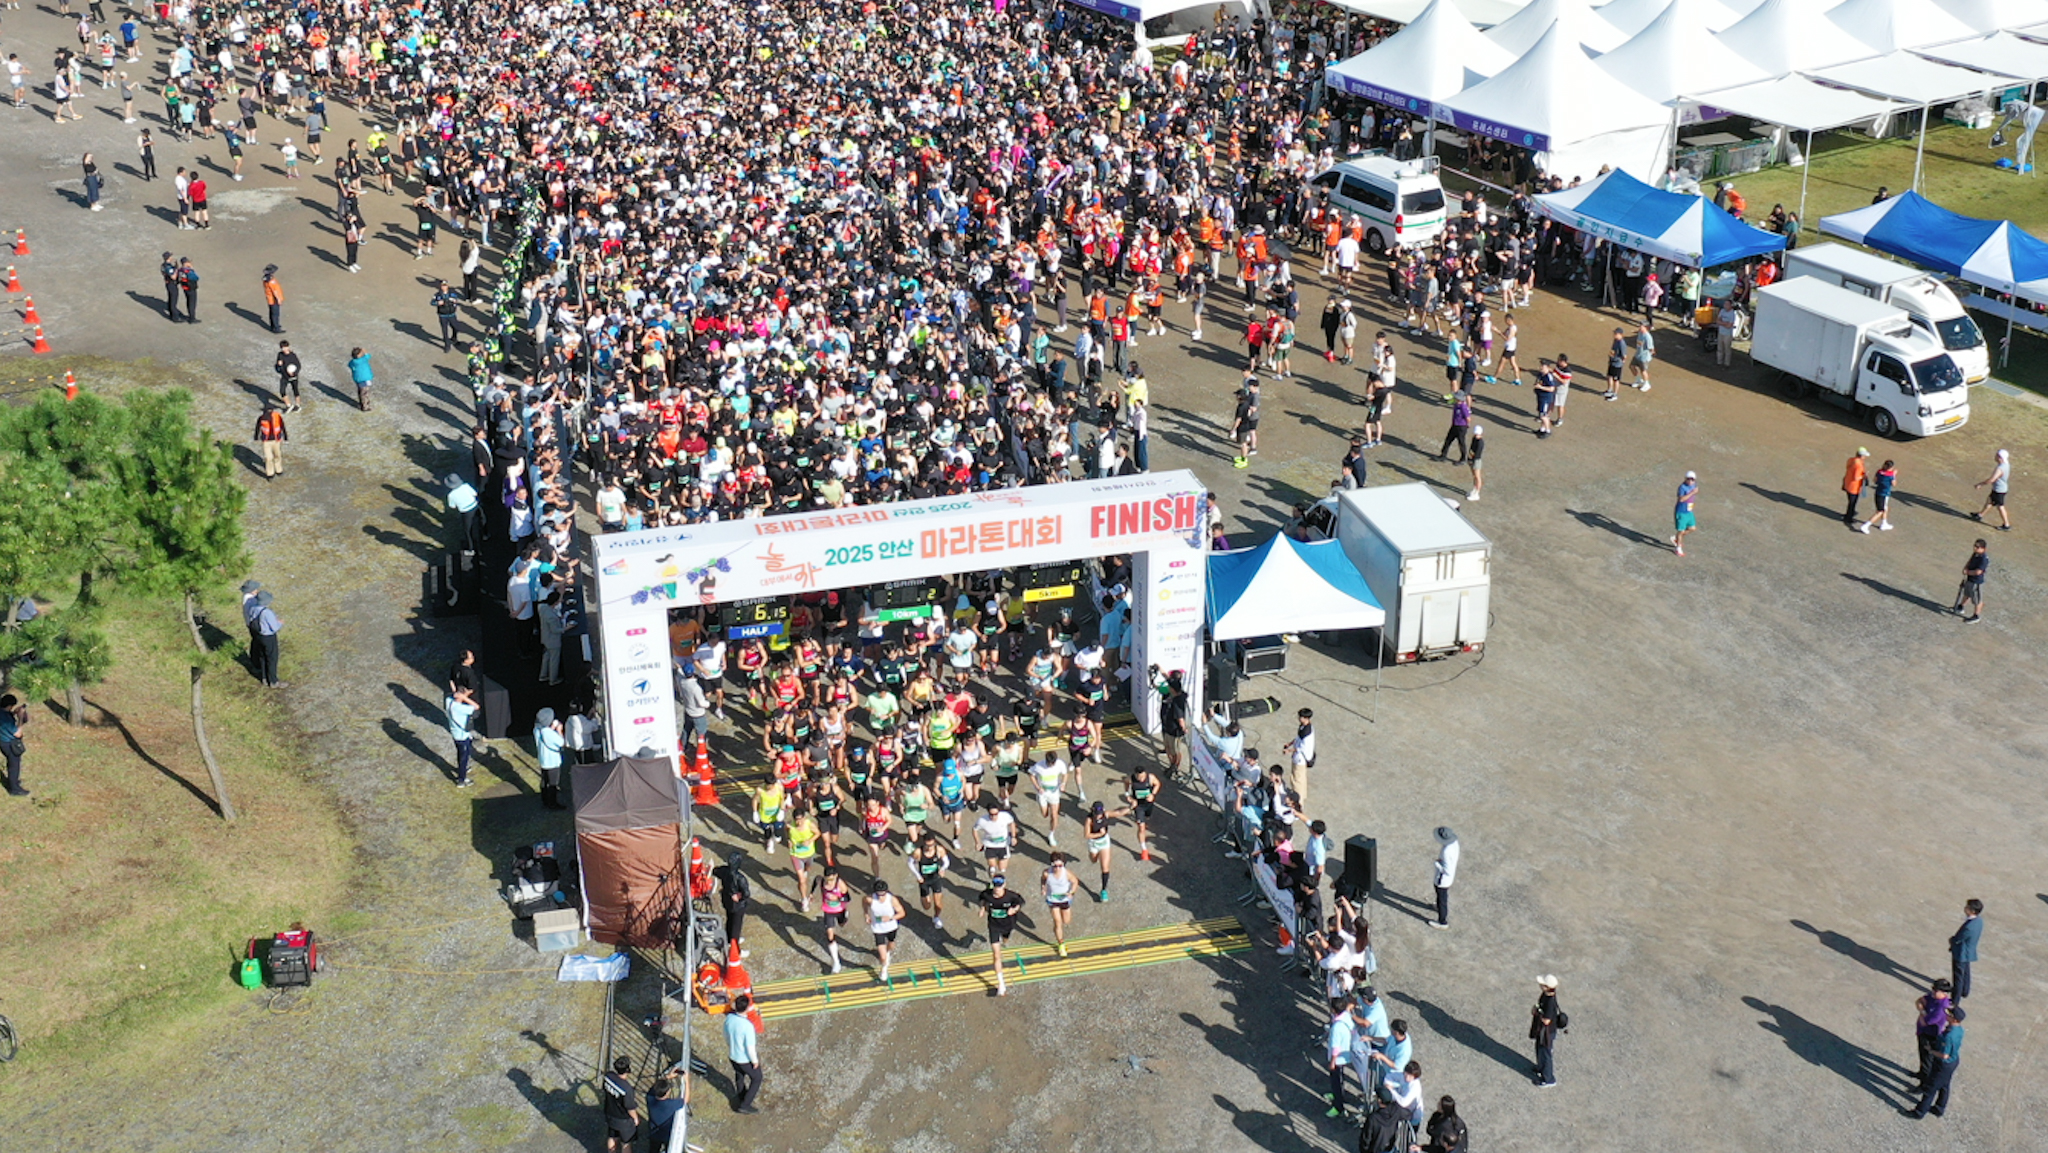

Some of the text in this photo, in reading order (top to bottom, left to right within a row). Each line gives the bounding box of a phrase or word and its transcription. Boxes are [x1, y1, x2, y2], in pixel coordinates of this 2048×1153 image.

[754, 500, 972, 535] 2025 안산 마라톤대회
[1090, 495, 1196, 539] FINISH
[825, 515, 1063, 566] 2025 안산 마라톤대회
[741, 626, 769, 637] HALF
[892, 608, 919, 620] 10km
